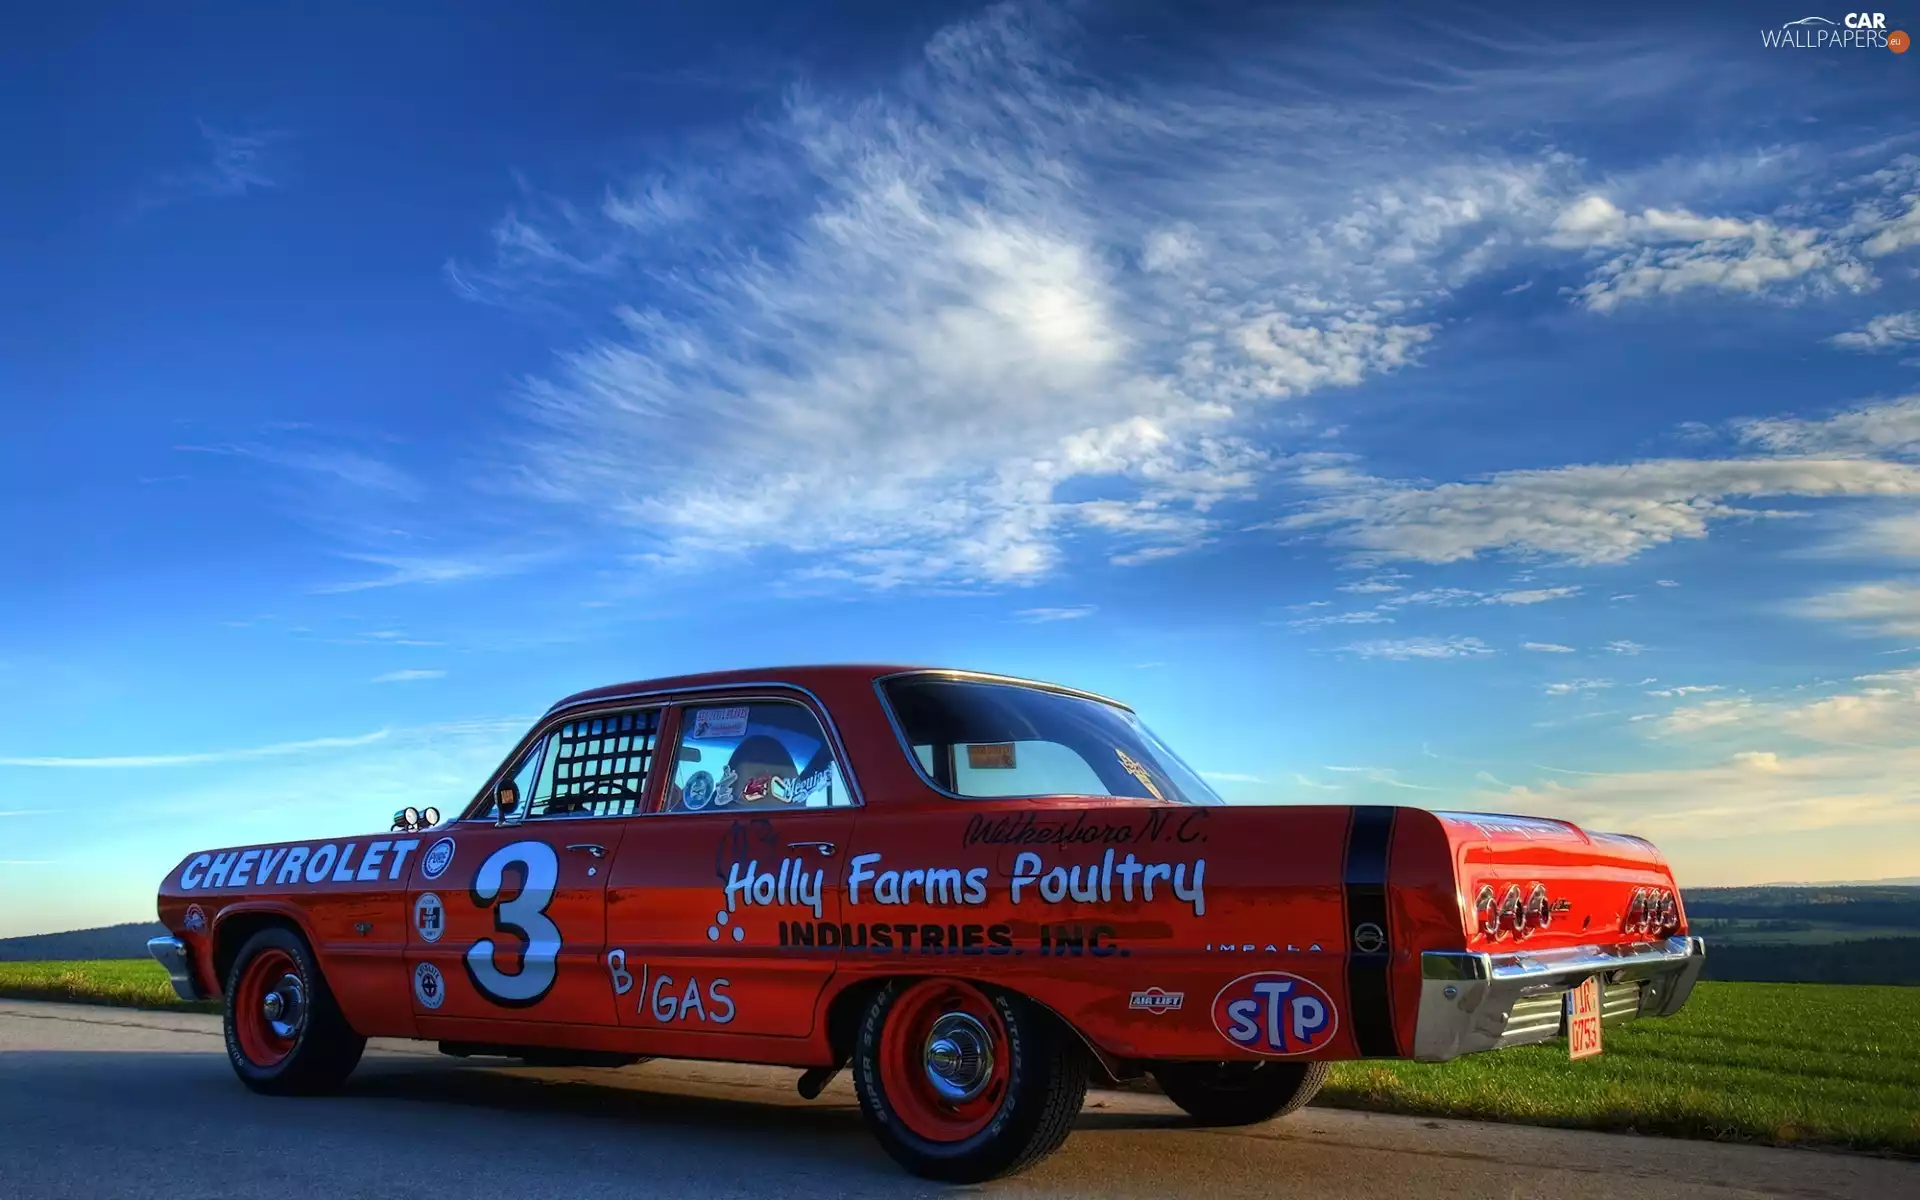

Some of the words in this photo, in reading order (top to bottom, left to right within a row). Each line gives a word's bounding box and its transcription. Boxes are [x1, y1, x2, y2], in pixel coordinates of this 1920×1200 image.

[180, 839, 420, 891] CHEVROLET
[724, 857, 824, 919] Holly
[848, 852, 988, 906] Farms
[1010, 848, 1207, 917] Poultry
[463, 839, 564, 1008] 3
[1039, 924, 1131, 957] INC.
[1206, 943, 1322, 952] IMPALA
[1132, 996, 1153, 1005] AIR
[1155, 996, 1180, 1005] LIFT
[1227, 981, 1329, 1051] STP
[862, 1056, 889, 1123] SUPER
